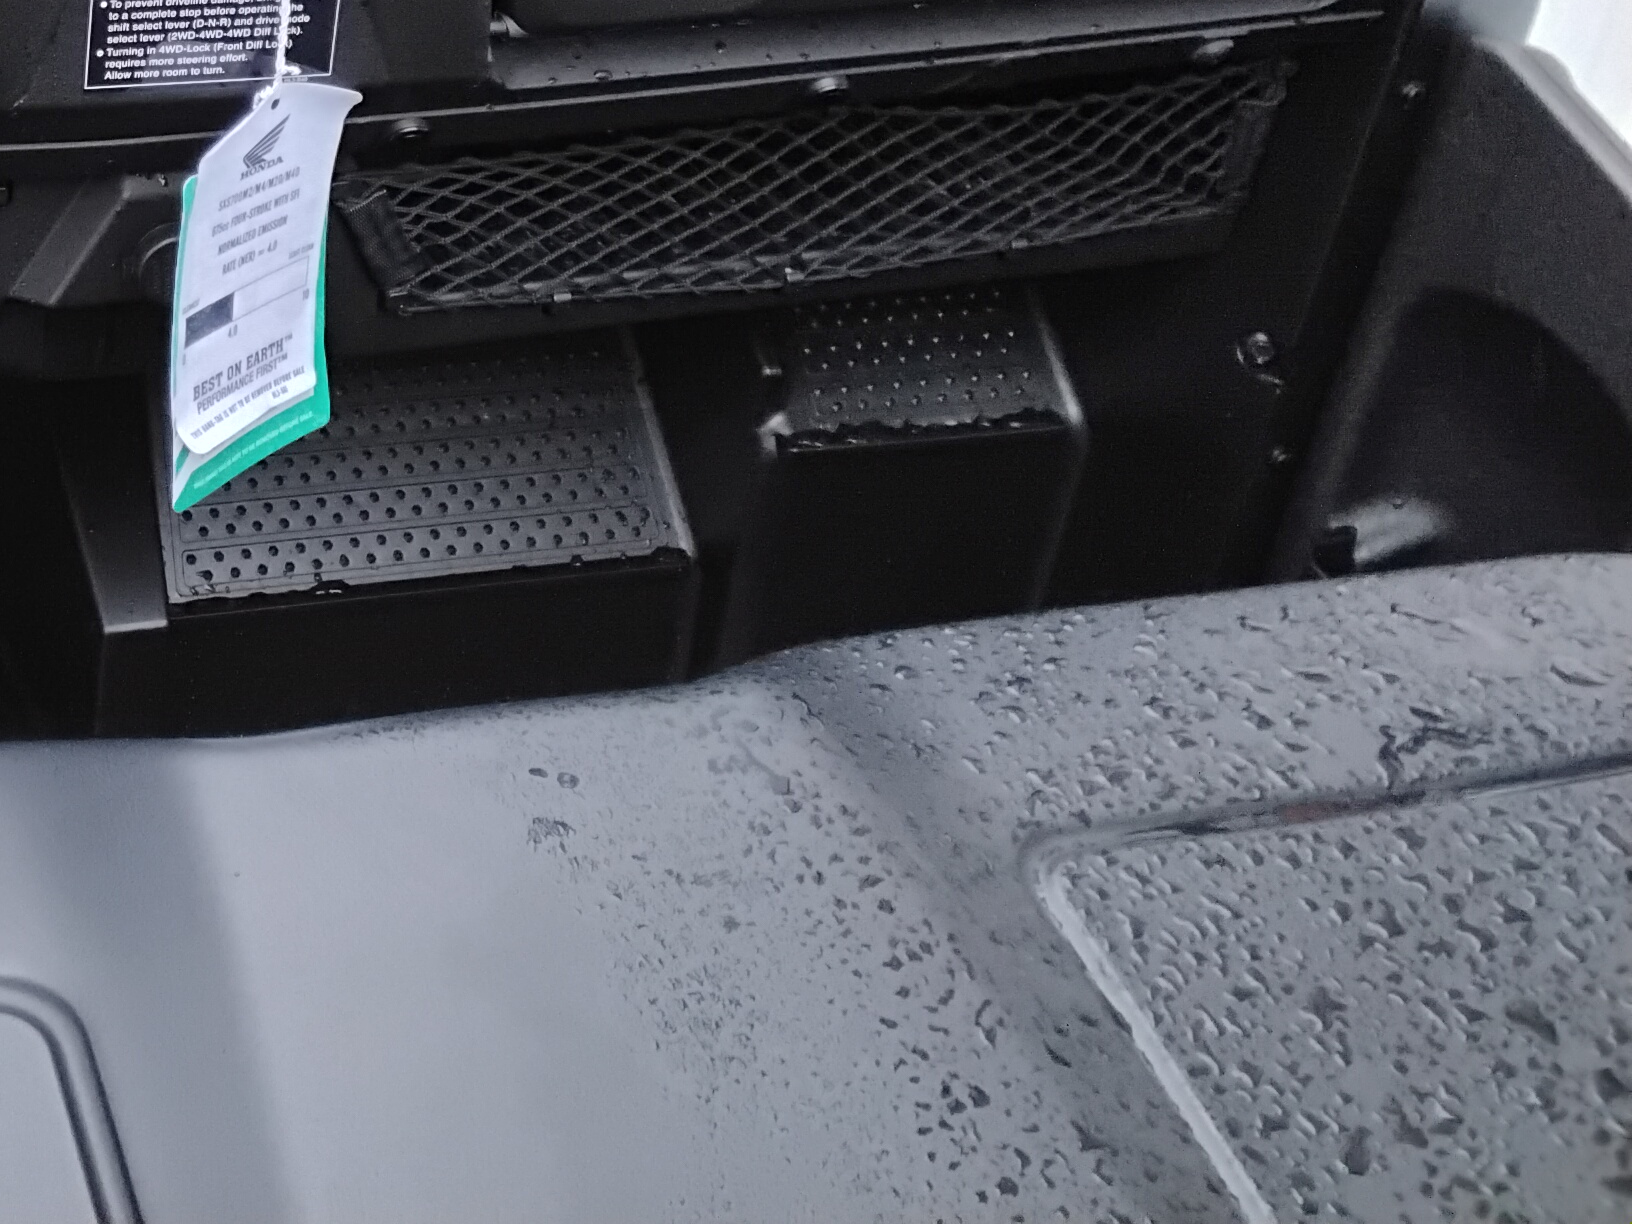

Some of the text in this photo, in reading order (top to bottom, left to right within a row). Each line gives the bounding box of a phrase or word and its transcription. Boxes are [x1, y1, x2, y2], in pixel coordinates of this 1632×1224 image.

[109, 0, 122, 9] To
[109, 12, 119, 20] to
[131, 9, 177, 20] complete
[179, 8, 201, 18] stop
[204, 6, 236, 15] before
[108, 14, 310, 32] shift select lever (D-N-R) and drive ode
[107, 26, 303, 43] select lever (2WD-4WD-4WD Diff Lck).
[106, 47, 144, 57] Turning
[147, 46, 156, 54] in
[159, 43, 210, 54] 4WD-Lock
[213, 42, 243, 53] (Front
[246, 40, 263, 49] Diff
[105, 53, 248, 69] requires more steering effort.
[104, 66, 225, 80] Allow more room to turn.
[240, 156, 284, 181] HONDA
[231, 200, 273, 227] FOUR-STROKE
[274, 192, 290, 209] WITH
[217, 215, 288, 256] NORMALIZED EMISSION
[222, 259, 237, 275] RATE
[267, 239, 277, 253] 4.0
[228, 324, 238, 338] 4.0
[292, 365, 305, 378] SALE
[193, 371, 223, 402] BEST
[227, 361, 242, 380] ON
[196, 369, 254, 415] PERFORMANCE
